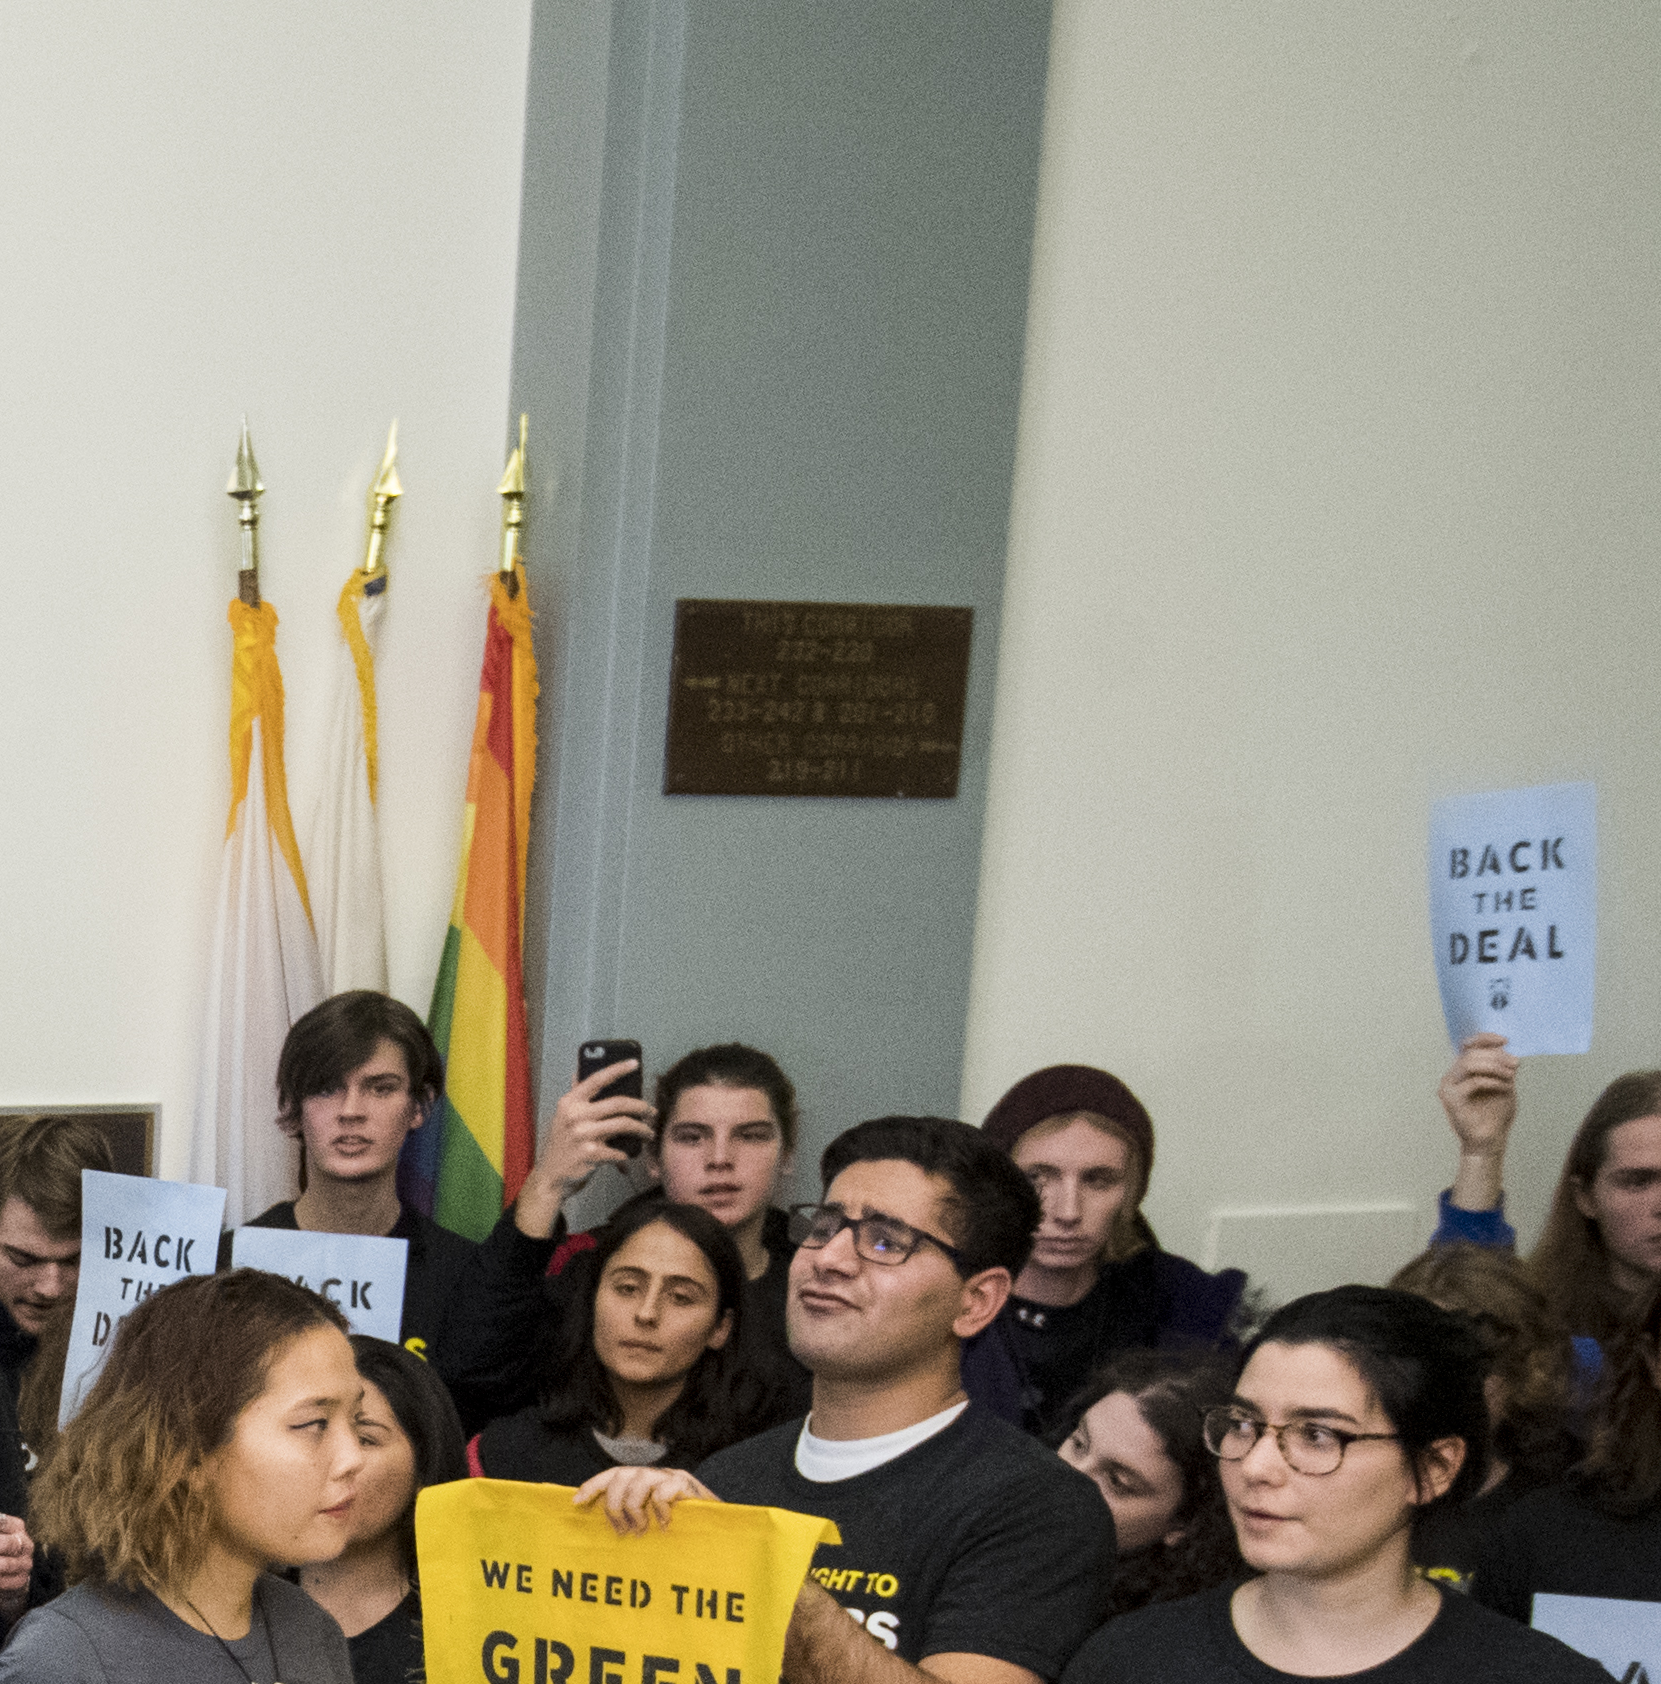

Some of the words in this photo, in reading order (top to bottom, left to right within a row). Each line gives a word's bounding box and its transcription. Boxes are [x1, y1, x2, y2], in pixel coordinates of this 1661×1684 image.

[1449, 837, 1565, 879] BACK
[1472, 887, 1537, 914] THE
[1448, 925, 1565, 965] DEAL
[104, 1226, 195, 1274] BACK
[480, 1559, 534, 1594] WE
[551, 1568, 653, 1610] NEED
[670, 1584, 746, 1624] THE
[865, 1573, 899, 1598] TO
